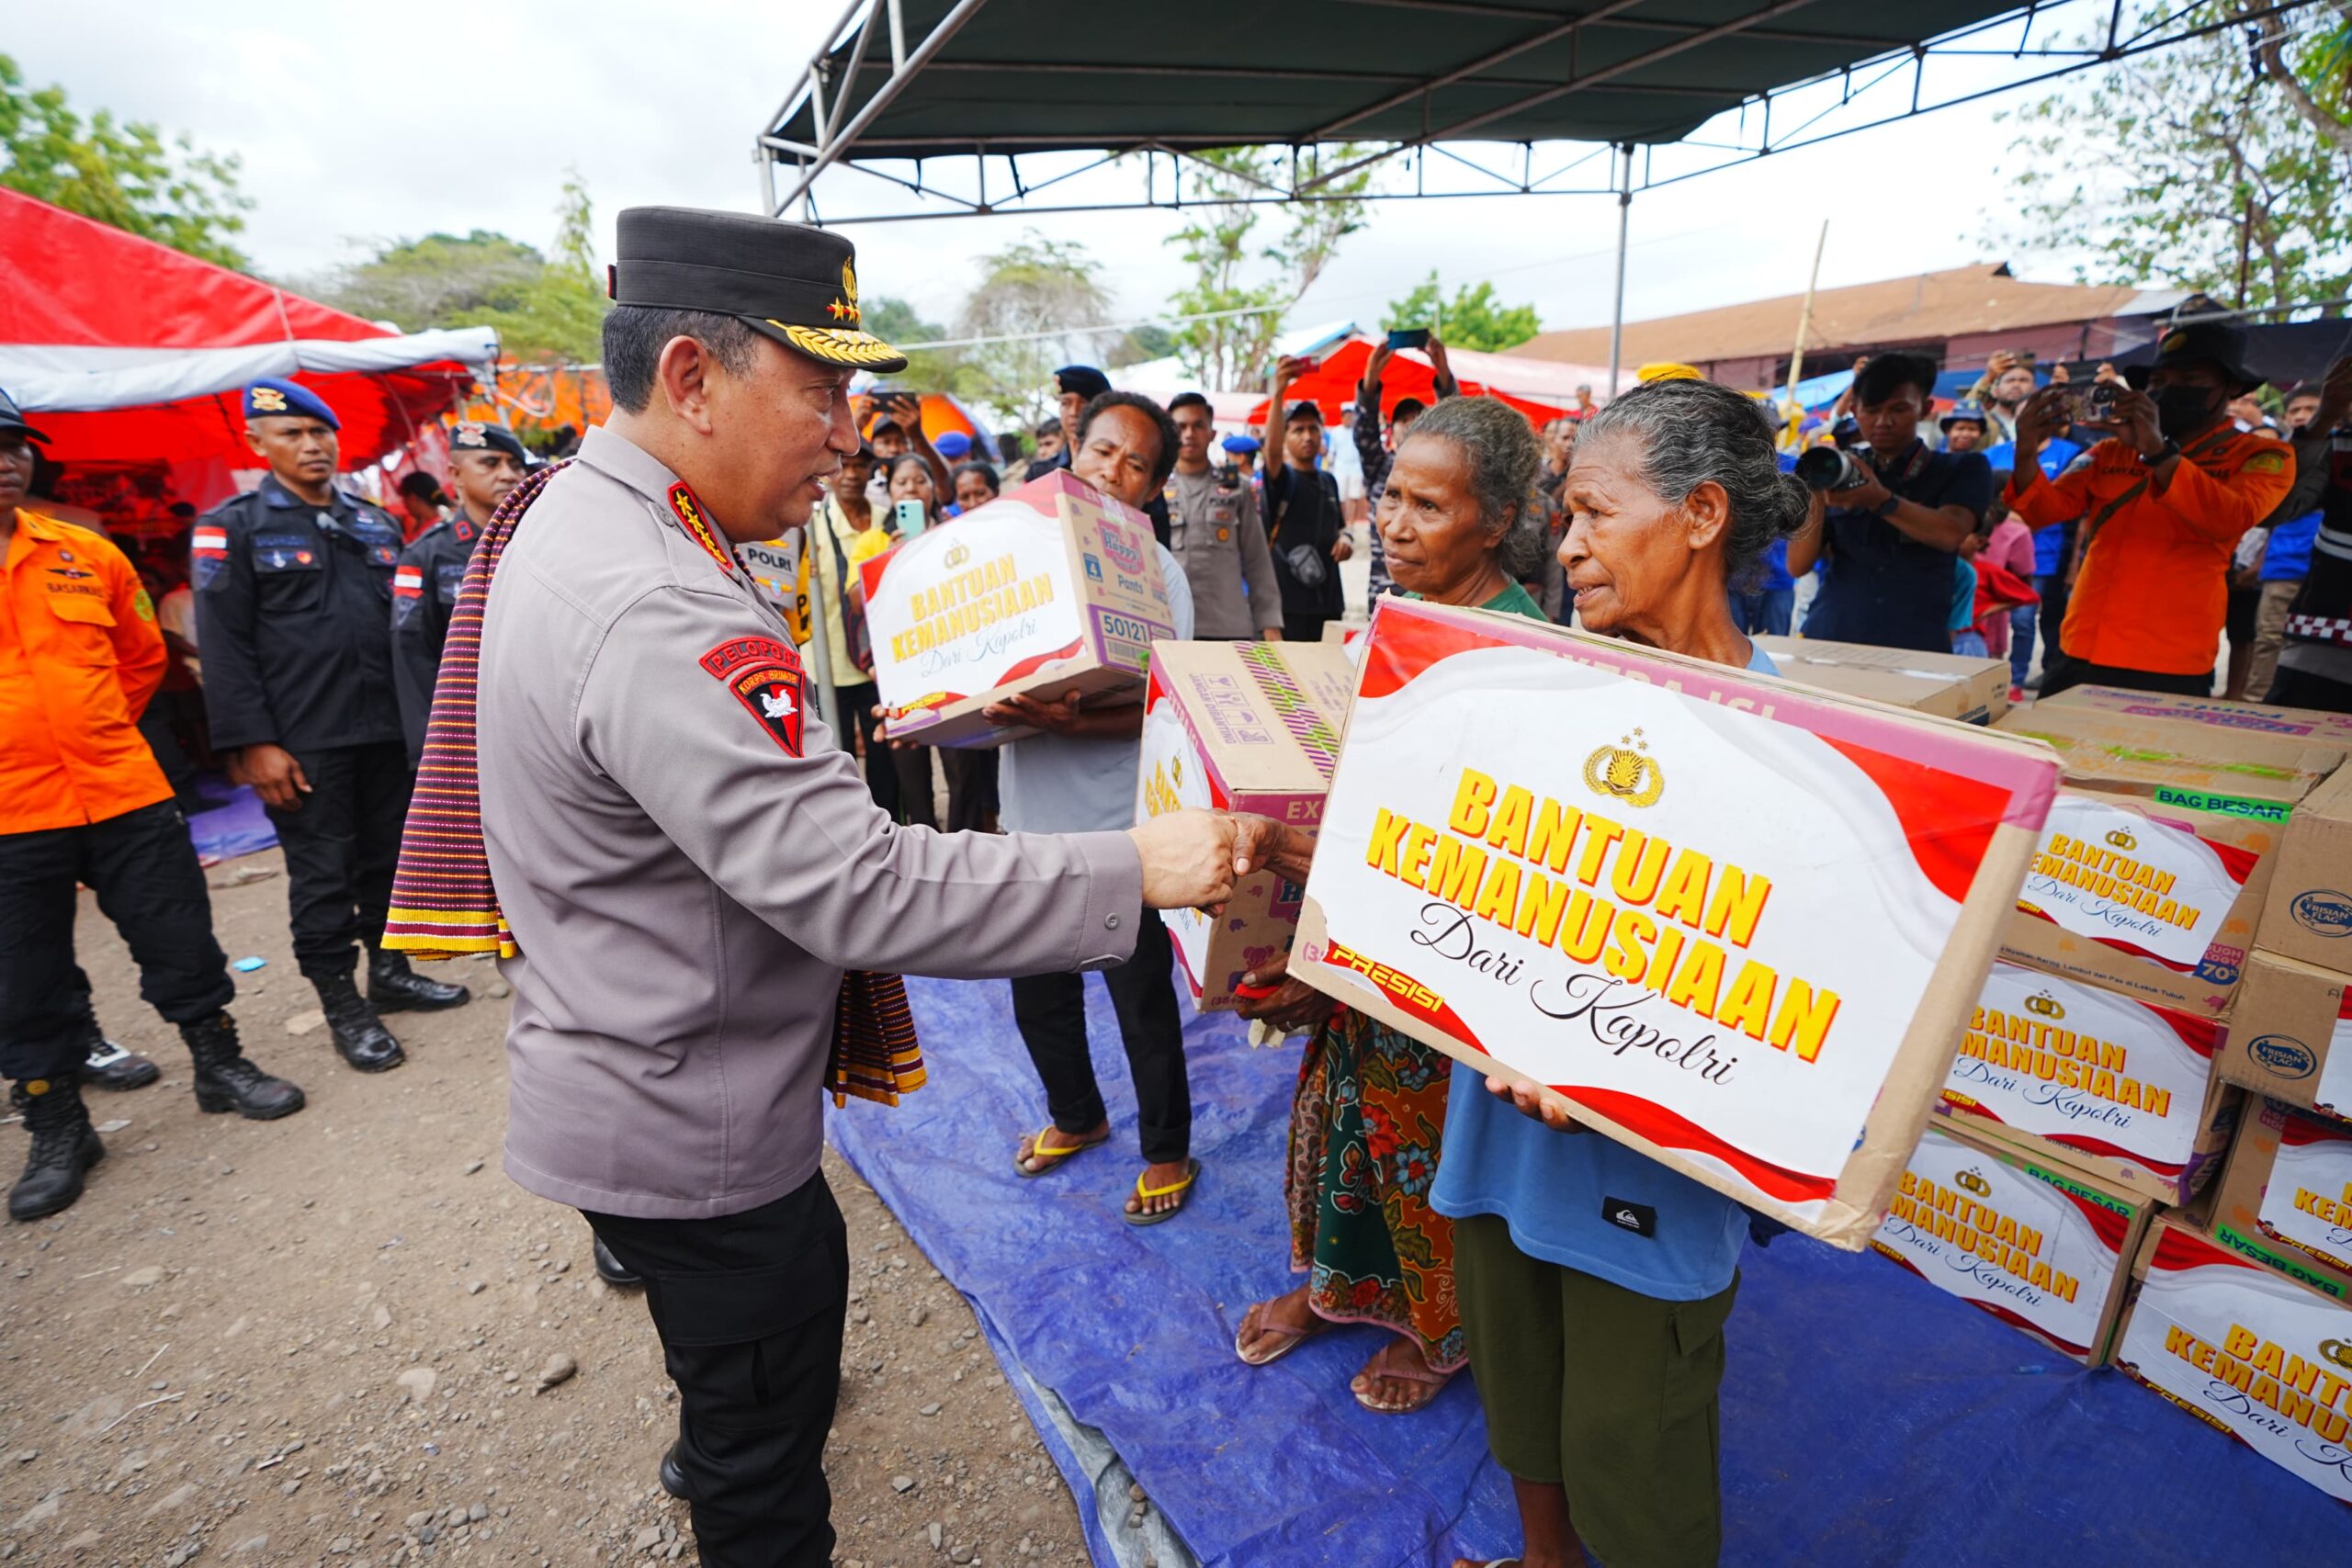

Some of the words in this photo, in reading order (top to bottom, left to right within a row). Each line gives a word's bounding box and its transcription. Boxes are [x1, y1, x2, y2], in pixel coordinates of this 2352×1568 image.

[747, 548, 793, 572] POLRI
[910, 552, 1017, 622] BANTUAN
[1117, 574, 1144, 595] Pants
[890, 572, 1056, 663] KEMANUSIAAN
[922, 646, 962, 678] Dari
[967, 616, 1036, 662] Kapolri
[1103, 615, 1148, 643] 50121
[711, 641, 795, 671] PELOPOR
[737, 672, 766, 695] KORPS
[768, 669, 797, 684] BRIMOB
[2159, 789, 2202, 808] BAG
[2207, 797, 2284, 821] BESAR
[1448, 767, 1772, 949] BANTUAN
[2048, 833, 2177, 896] BANTUAN
[1365, 807, 1841, 1064] KEMANUSIAAN
[2027, 875, 2078, 904] Dari
[2080, 898, 2164, 938] Kapolri
[2305, 904, 2349, 919] FRISIAN
[2311, 911, 2339, 924] FLAG
[1332, 944, 1445, 1012] PRESISI
[1410, 902, 1523, 985] Dari
[1531, 974, 1738, 1085] Kapolri
[2262, 1045, 2302, 1064] FRISIAN
[2267, 1054, 2293, 1066] FLAG
[1953, 1057, 2017, 1092] Dari
[2023, 1083, 2132, 1129] Kapolri
[1898, 1170, 2043, 1257] BANTUAN
[1883, 1216, 1941, 1257] Dari
[1945, 1253, 2041, 1309] Kapolri
[2220, 1229, 2287, 1273] BESAR
[2293, 1268, 2340, 1297] BAG
[2165, 1325, 2352, 1454] KEMANU
[2203, 1381, 2289, 1438] Dari
